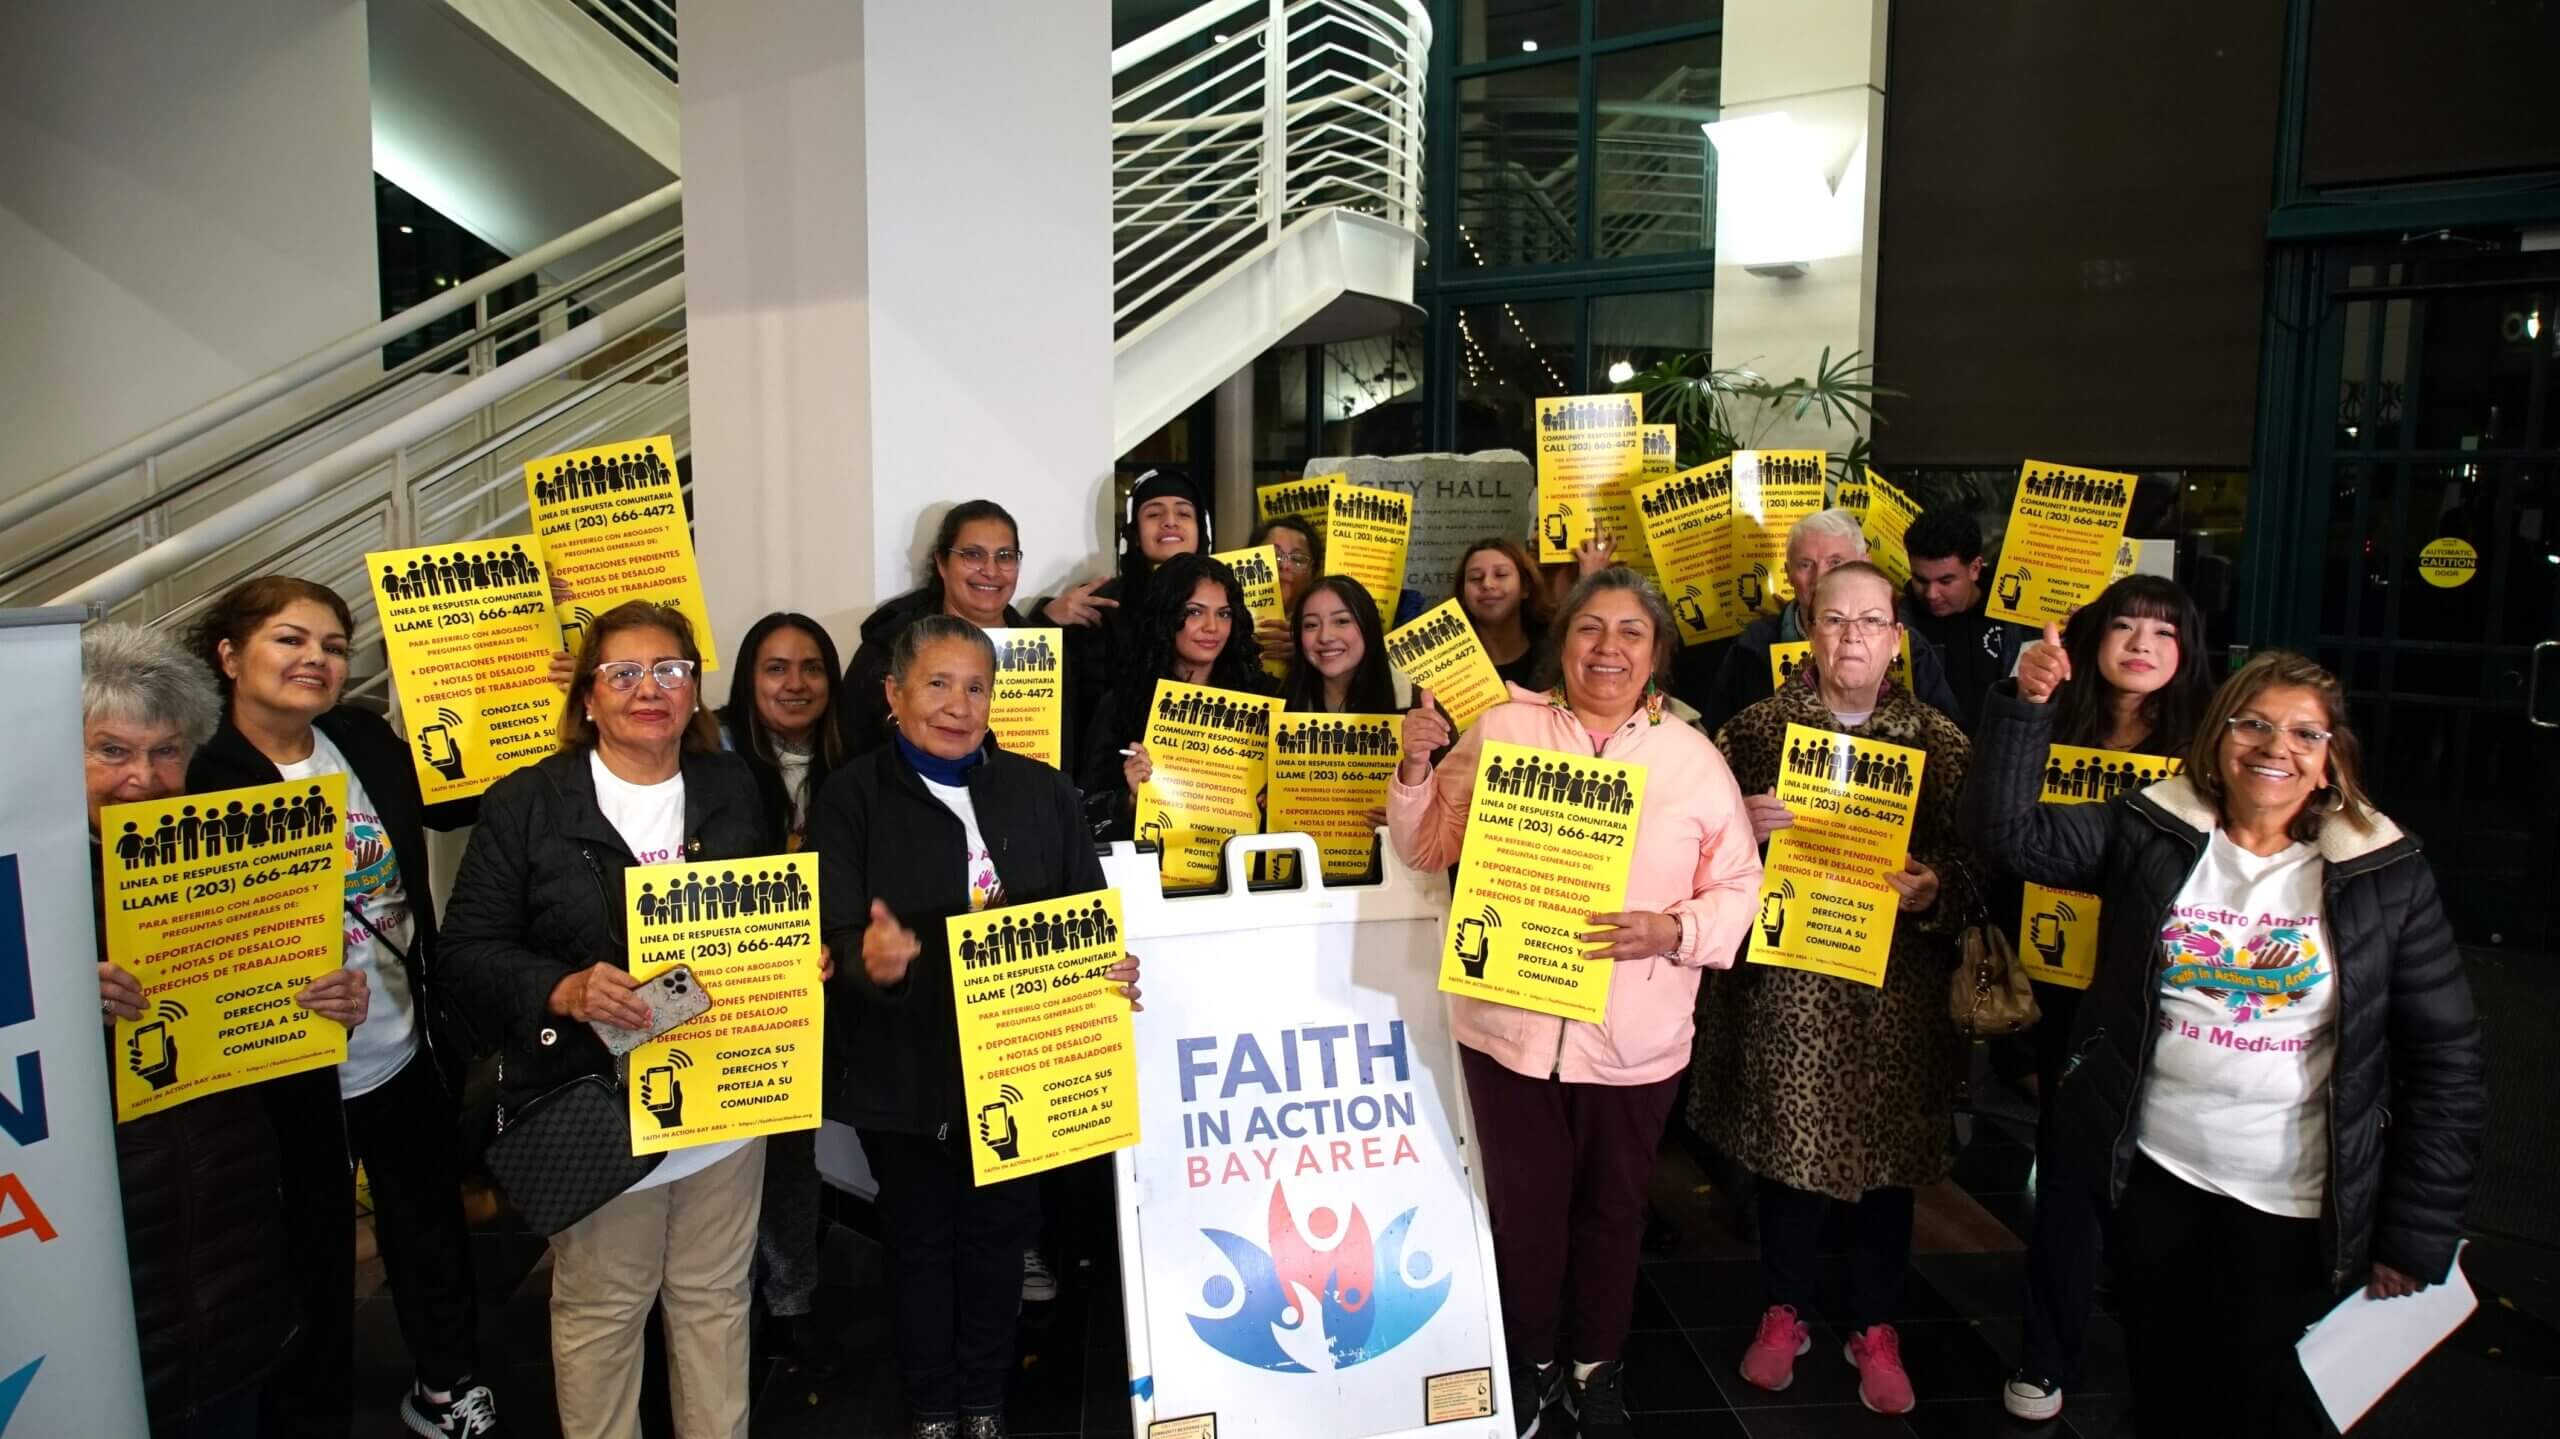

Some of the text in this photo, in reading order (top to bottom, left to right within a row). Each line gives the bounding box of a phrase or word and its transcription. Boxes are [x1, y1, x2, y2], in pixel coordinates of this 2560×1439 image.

[1436, 480, 1512, 498] HALL
[538, 491, 673, 521] LINEA DE RESPUESTA COMUNITARIA
[1766, 499, 1788, 509] (203)
[541, 503, 675, 536] LLAME (203) 666-4472
[1333, 529, 1352, 538] CALL
[2420, 558, 2476, 567] CAUTION
[389, 590, 542, 616] LINEA DE RESPUESTA COMUNITARIA
[394, 601, 545, 632] LLAME (203) 666-4472
[1435, 645, 1477, 673] 666-4472
[999, 688, 1054, 699] 666-4472
[1153, 723, 1206, 738] COMMUNITY
[1207, 732, 1249, 745] RESPONSE
[1152, 735, 1264, 760] CALL (203) 666-4472
[1276, 771, 1305, 779] LLAME
[1308, 770, 1337, 782] (203)
[1347, 760, 1396, 768] COMUNITARIA
[1784, 779, 1907, 811] LINEA DE RESPUESTA COMUNITARIA
[1480, 798, 1627, 830] LINEA DE RESPUESTA COMUNITARIA
[1781, 792, 1904, 826] LLAME (203) 666-4472
[1478, 812, 1624, 847] LLAME (203) 666-4472
[120, 842, 333, 890] LINEA DE RESPUESTA COMUNITARIA
[122, 856, 331, 911] LLAME (203) 666-4472
[138, 883, 319, 930] PARA REFERIRLO CON ABOGADOS Y
[2257, 912, 2320, 927] Amor
[145, 930, 248, 964] DEPORTACIONES
[253, 913, 325, 936] PENDIENTES
[639, 918, 810, 944] LINEA DE RESPUESTA COMUNITARIA
[1521, 921, 1569, 937] CONOZCA
[171, 935, 301, 973] NOTAS DE DESALOJO
[641, 932, 810, 963] LLAME (203) 666-4472
[1524, 937, 1583, 957] DERECHOS Y
[143, 945, 327, 998] DERECHOS DE TRABAJADORES
[963, 950, 1117, 987] LINEA DE RESPUESTA COMUNITARIA
[1517, 952, 1584, 973] PROTEJA A SU
[215, 975, 312, 1003] CONOZCA SUS
[966, 988, 1005, 1004] LLAME
[1010, 978, 1047, 998] (203)
[1517, 969, 1578, 988] COMUNIDAD
[2215, 970, 2254, 986] Action
[2256, 975, 2280, 990] Bay
[2284, 966, 2311, 987] Area
[223, 996, 290, 1020] DERECHOS
[748, 987, 807, 1003] PENDIENTES
[218, 1006, 311, 1039] PROTEJA A SU
[719, 1012, 732, 1021] DE
[735, 1005, 788, 1019] DESALOJO
[223, 1029, 306, 1056] COMUNIDAD
[656, 1017, 809, 1043] DERECHOS DE TRABAJADORES
[985, 1014, 1118, 1050] DEPORTACIONES PENDIENTES
[2180, 1020, 2200, 1039] la
[716, 1043, 795, 1060] CONOZCA SUS
[1006, 1032, 1102, 1060] NOTAS DE DESALOJO
[722, 1060, 788, 1075] DERECHOS Y
[987, 1042, 1122, 1079] DERECHOS DE TRABAJADORES
[1176, 1020, 1410, 1103] FAITH
[717, 1076, 792, 1092] PROTEJA A SU
[720, 1092, 789, 1108] COMUNIDAD
[1183, 1109, 1231, 1148] IN
[1244, 1091, 1416, 1142] ACTION
[1186, 1134, 1420, 1188] BAY AREA
